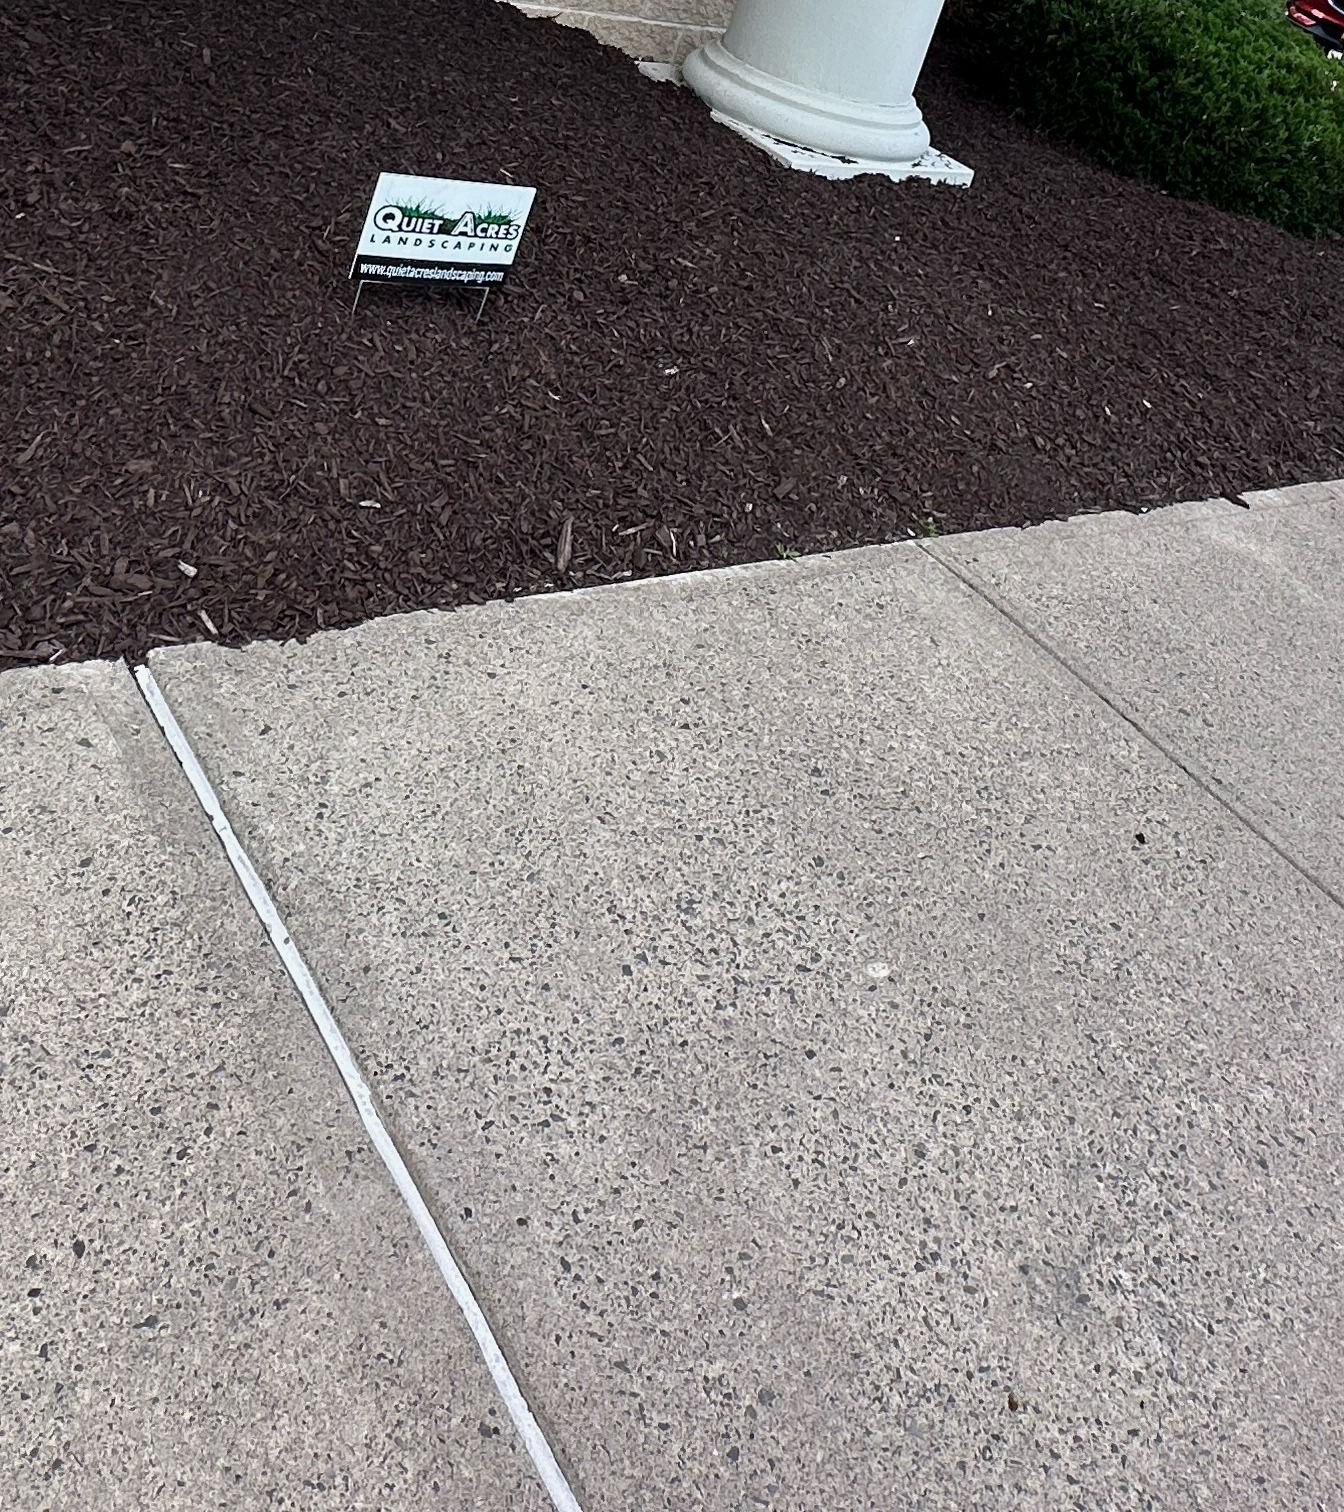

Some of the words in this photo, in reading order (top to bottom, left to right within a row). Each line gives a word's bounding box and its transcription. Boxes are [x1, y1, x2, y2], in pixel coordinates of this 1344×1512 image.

[374, 205, 444, 234] QUIET
[451, 211, 521, 240] ACRES
[370, 234, 513, 253] LANDSCAPING
[360, 263, 504, 283] www.quietacreslandscaping.com
